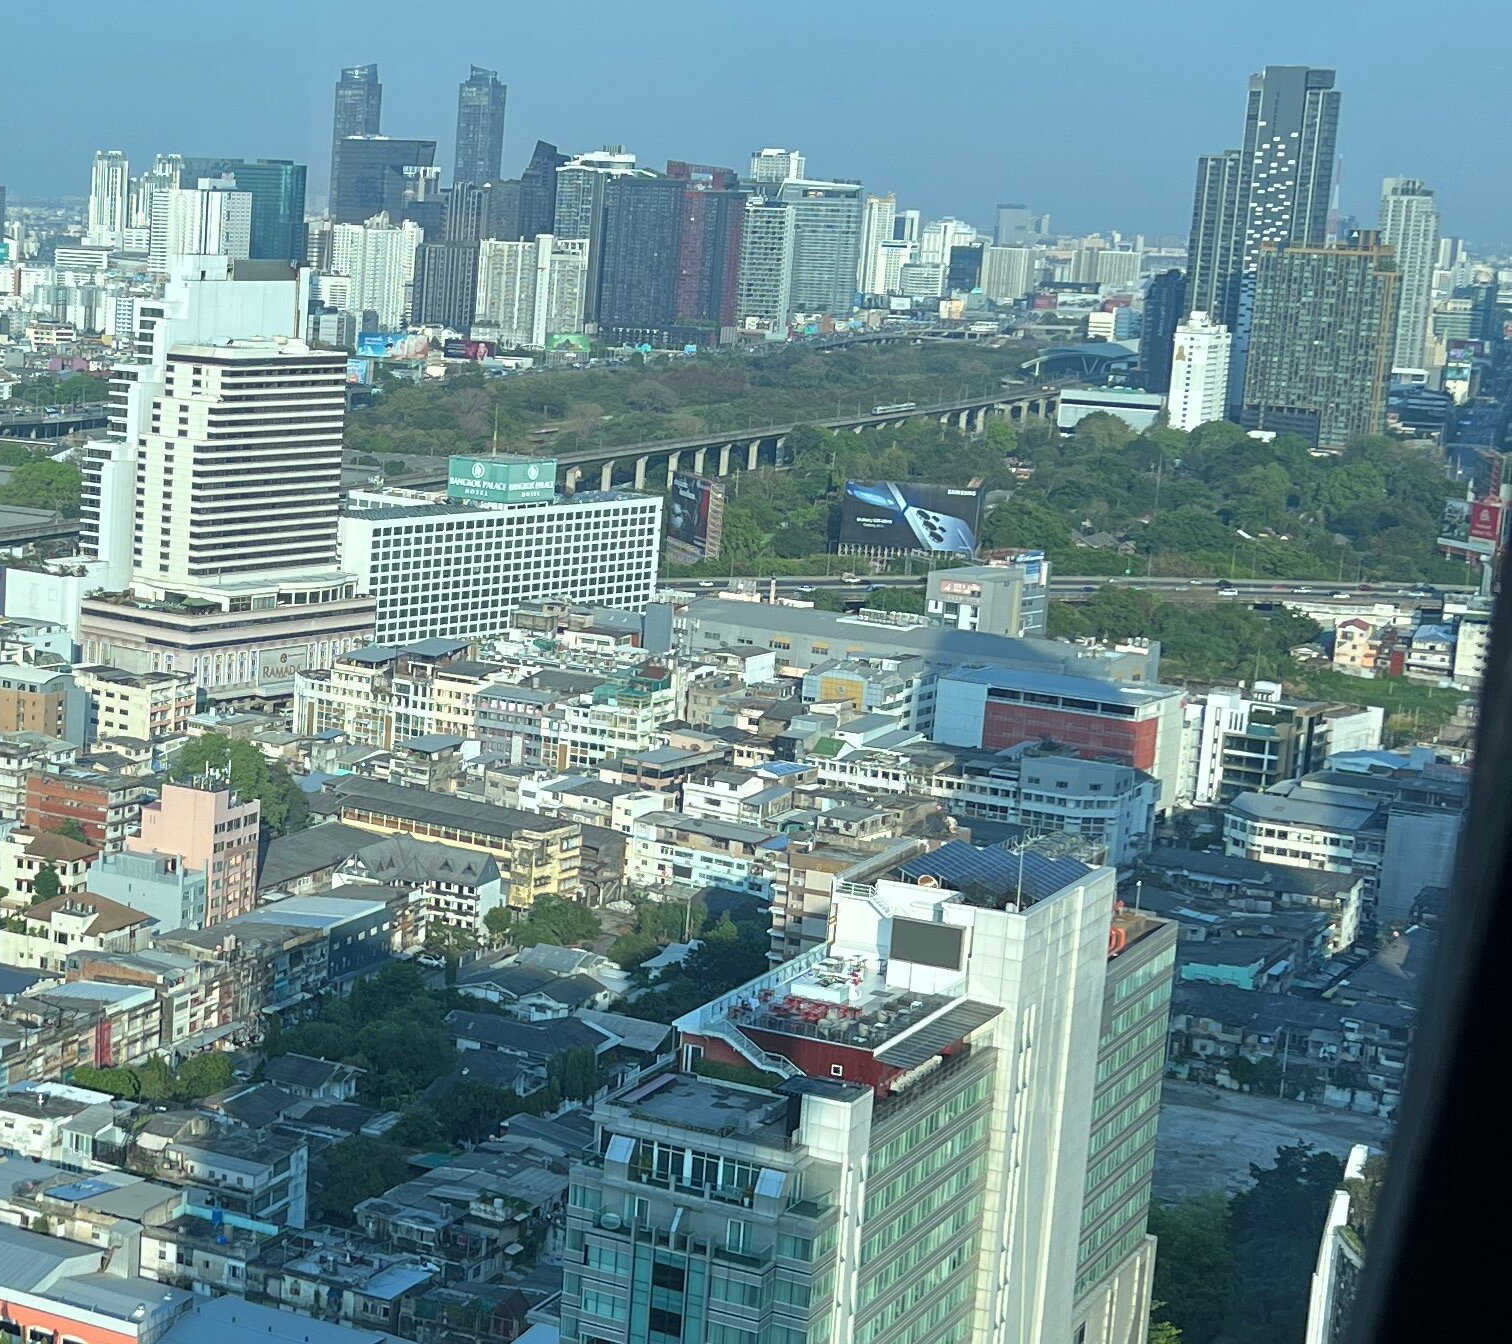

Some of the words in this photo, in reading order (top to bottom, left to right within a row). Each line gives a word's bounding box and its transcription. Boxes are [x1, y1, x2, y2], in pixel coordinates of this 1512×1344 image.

[449, 476, 482, 488] BANGKOK
[482, 480, 507, 491] PALACE
[464, 488, 488, 497] HOTEL
[262, 664, 301, 678] RAMADA
